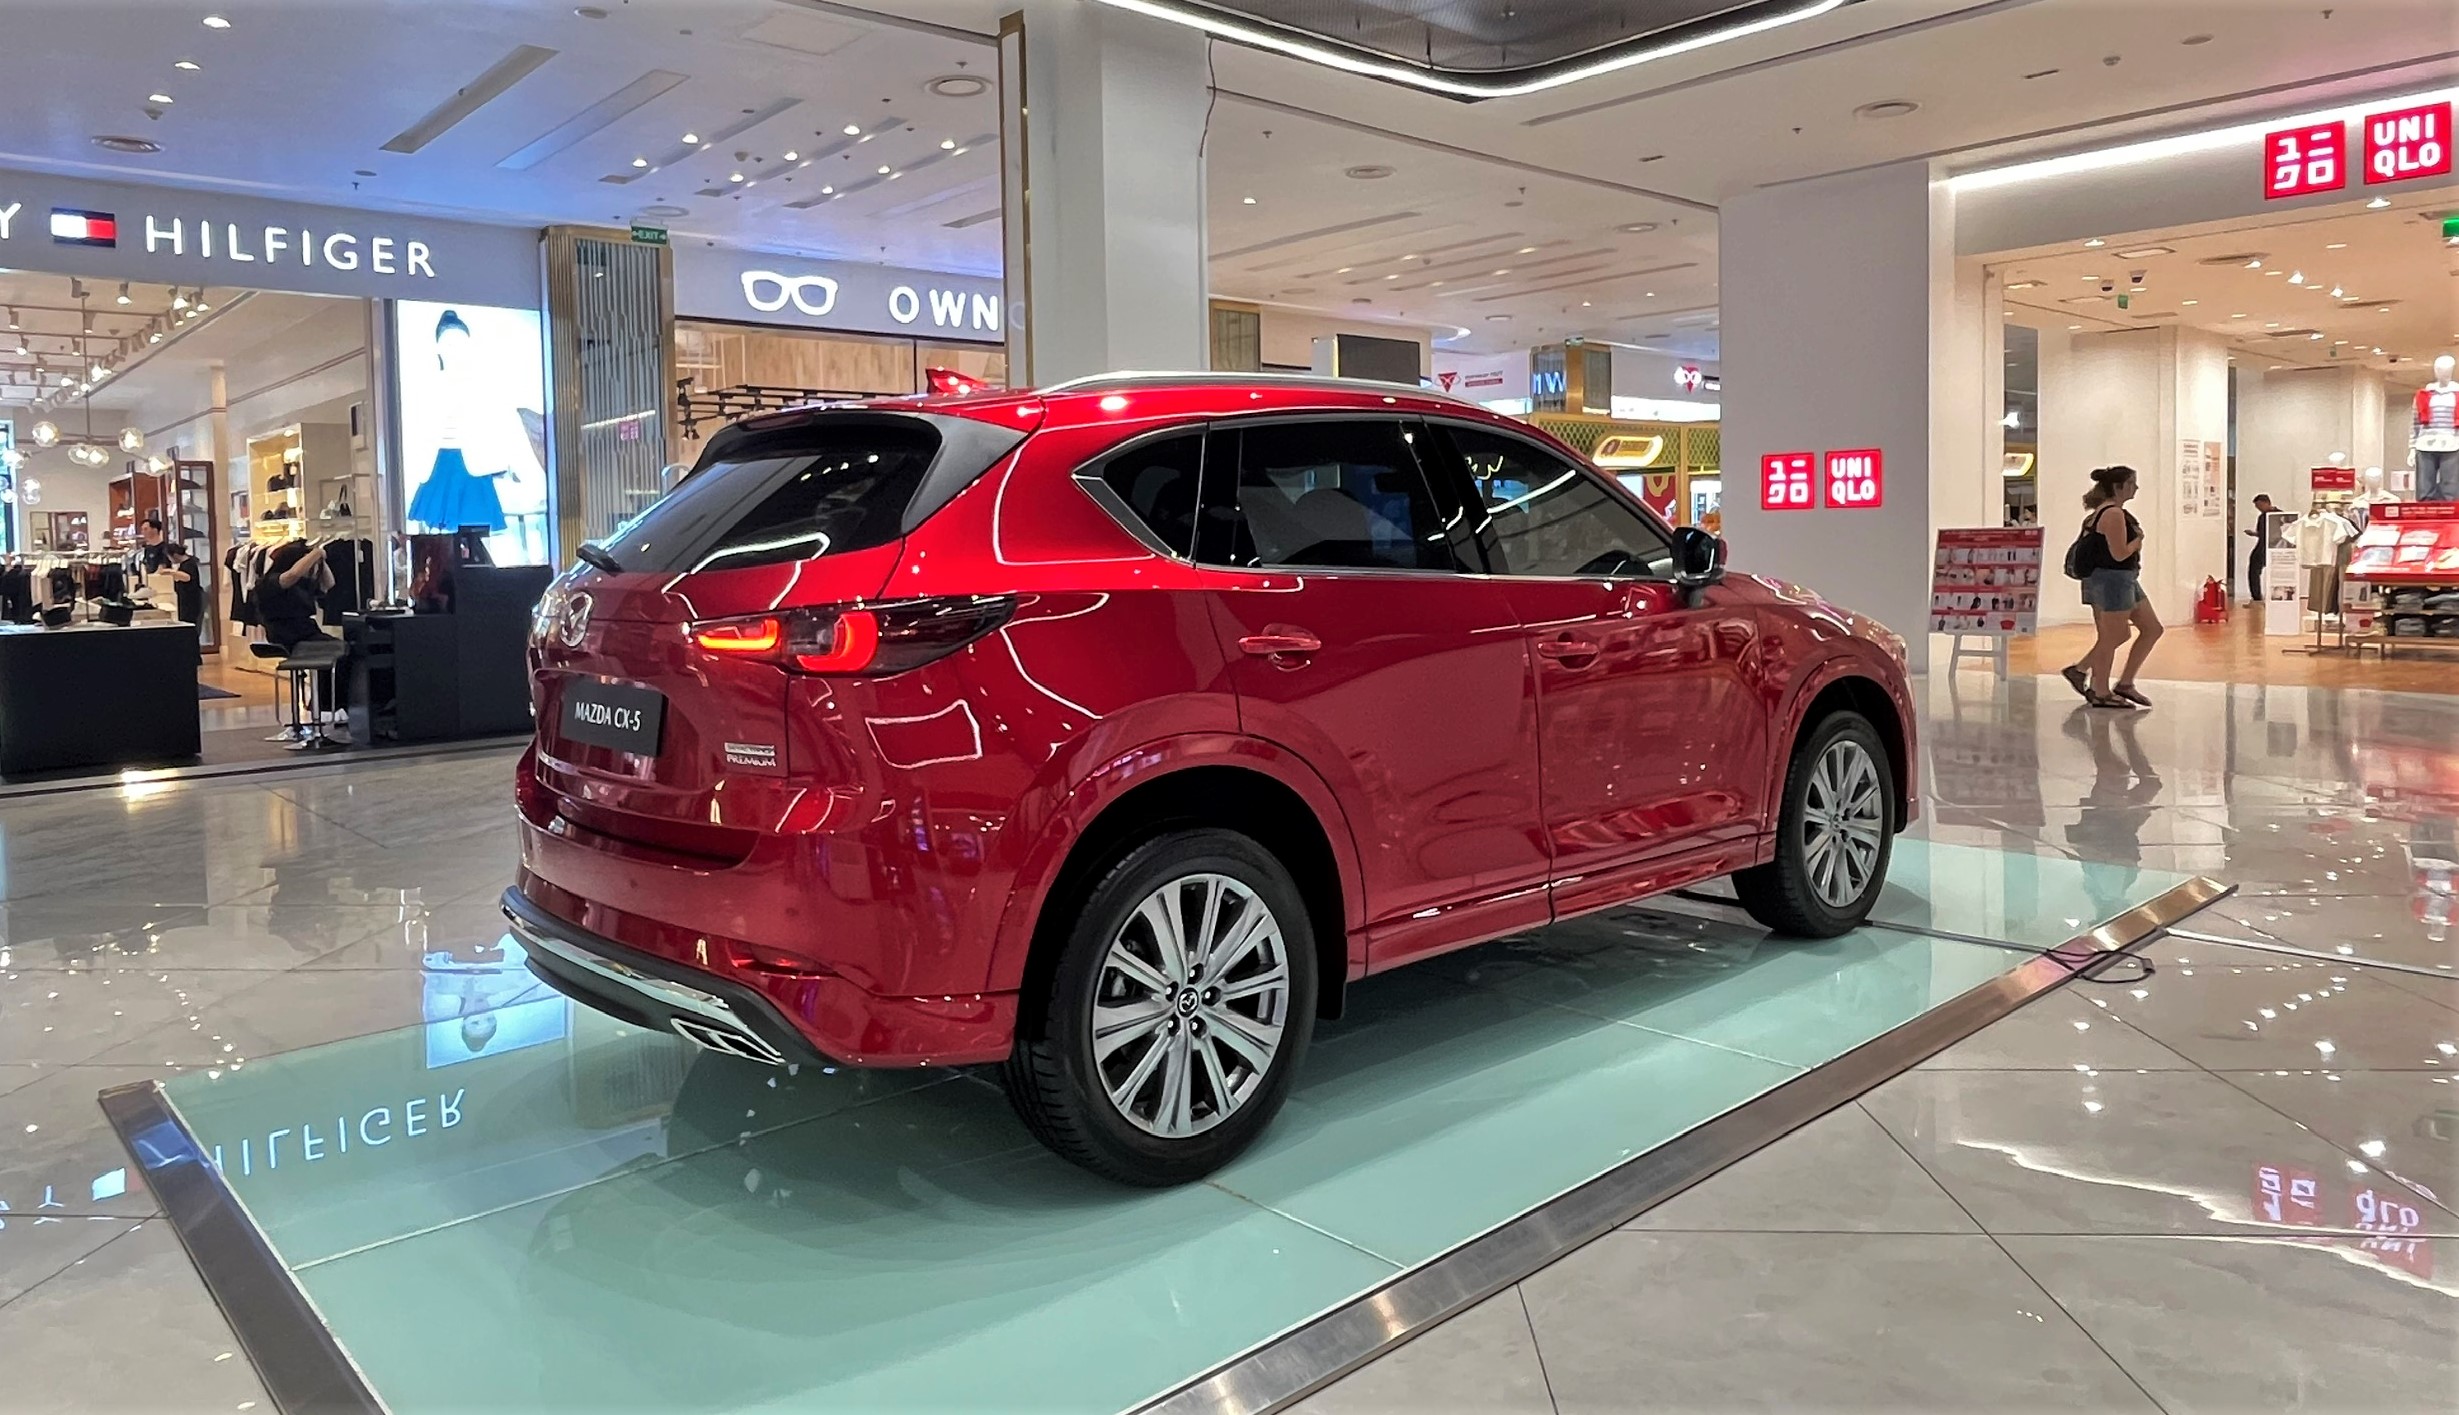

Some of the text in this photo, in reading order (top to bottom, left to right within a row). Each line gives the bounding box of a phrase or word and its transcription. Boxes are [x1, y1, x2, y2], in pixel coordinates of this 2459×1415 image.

[2375, 114, 2434, 145] UNI
[2276, 132, 2333, 162] ユニ
[2375, 143, 2440, 177] QLO
[2273, 158, 2334, 190] クロ
[146, 215, 436, 278] HILFIGER
[638, 230, 659, 240] EXIT
[888, 286, 999, 332] OWN
[1768, 459, 1807, 481] ユニ
[1831, 457, 1872, 478] UNI
[1767, 482, 1809, 503] クロ
[1831, 479, 1875, 504] QLO
[574, 701, 642, 731] MAZDA CX-5
[726, 754, 777, 767] PREMIUM
